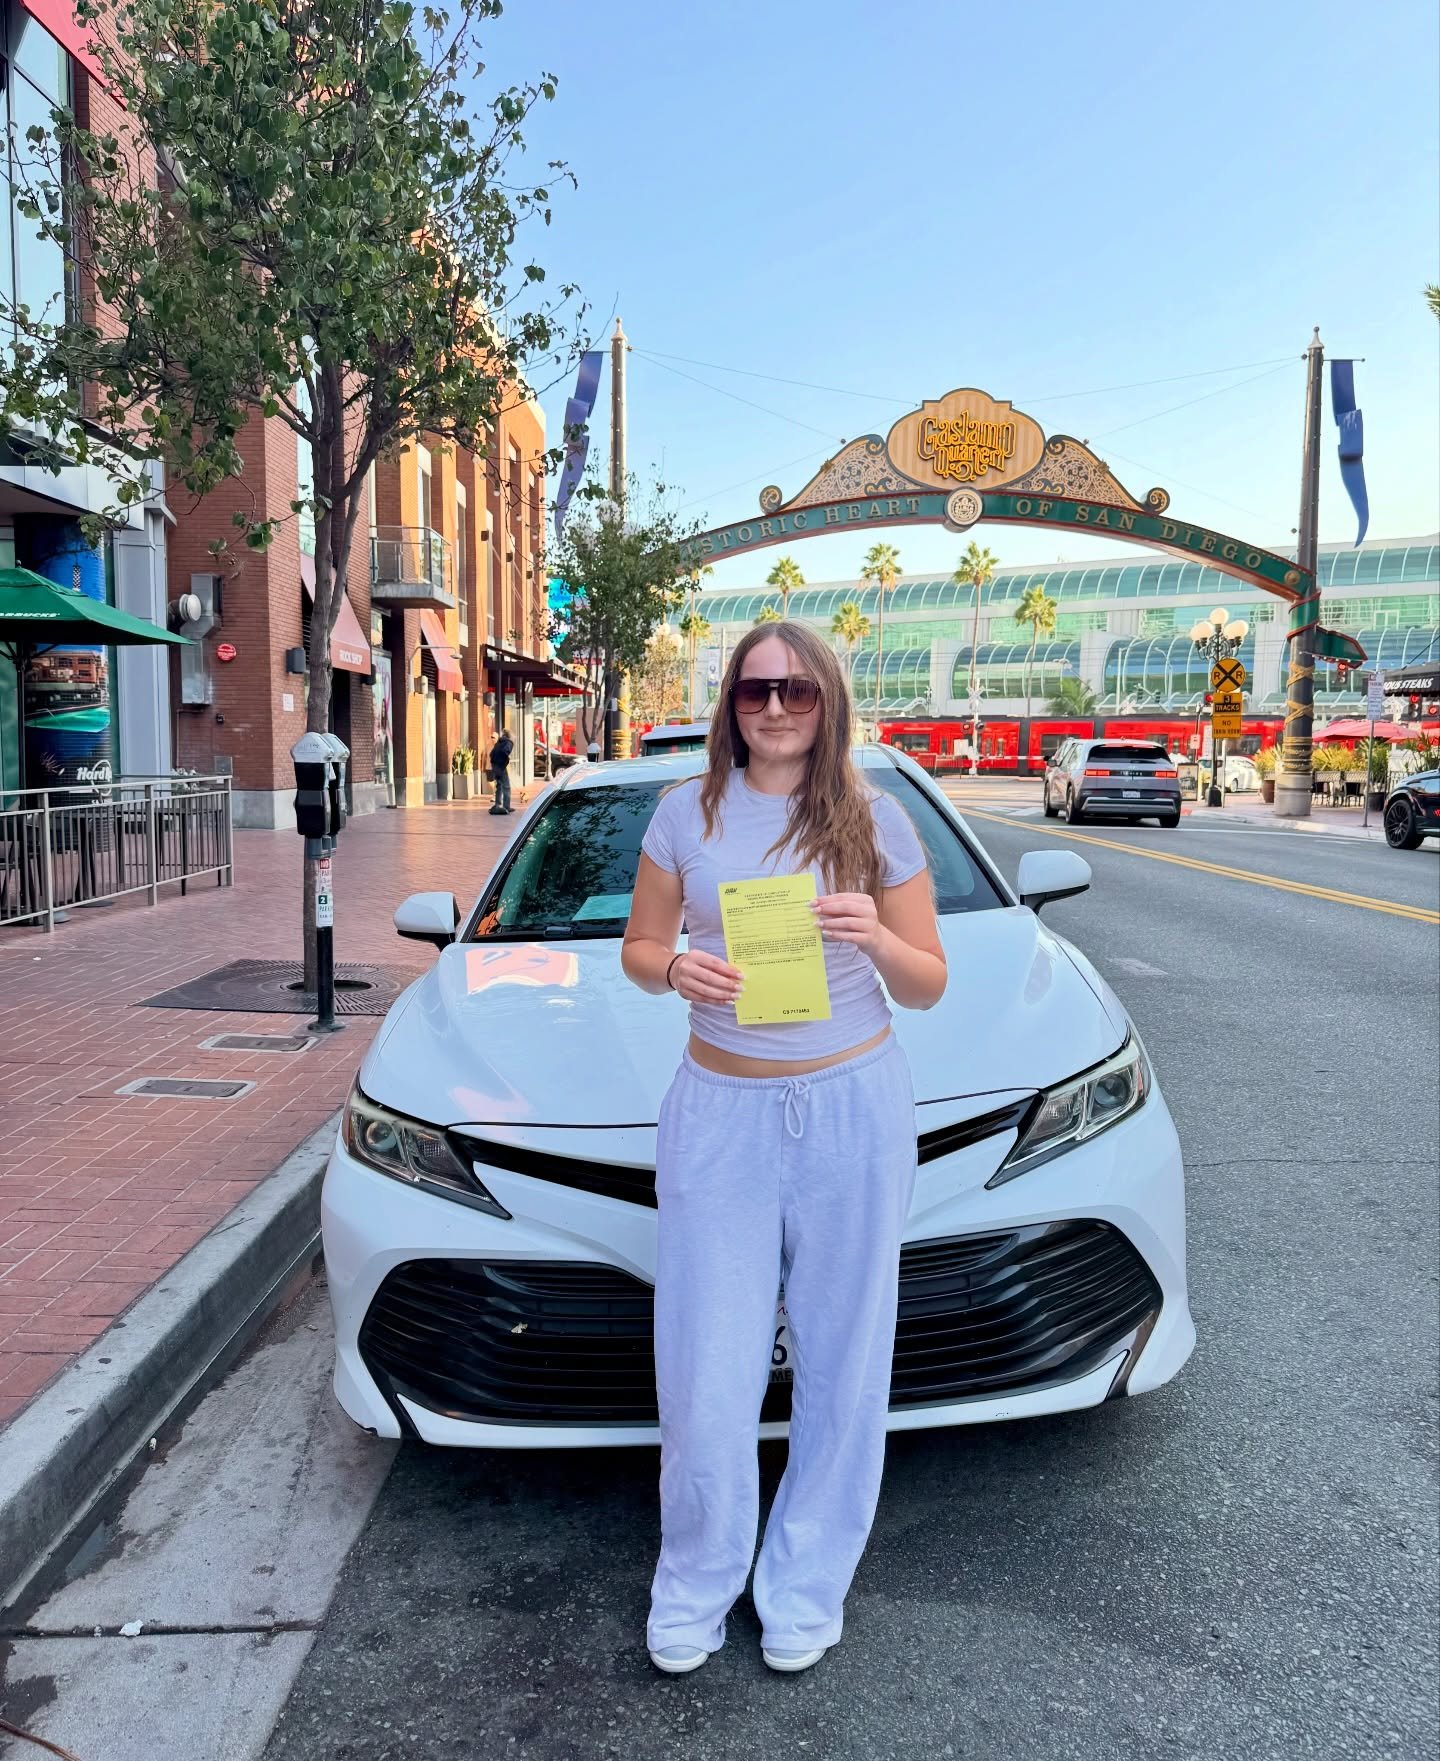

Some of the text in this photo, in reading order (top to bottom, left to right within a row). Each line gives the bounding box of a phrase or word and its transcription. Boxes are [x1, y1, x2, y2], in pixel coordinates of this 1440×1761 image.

[917, 409, 1016, 460] Gaslamp
[933, 444, 1005, 482] Quarter
[684, 512, 808, 558] ISTORIC
[823, 498, 921, 525] HEART
[1015, 499, 1053, 517] OF
[1074, 504, 1137, 531] SAN
[1160, 524, 1261, 568] DIEGO
[1213, 670, 1243, 680] R R
[1383, 678, 1434, 690] OUS STEAKS
[1224, 695, 1231, 703] 3
[1215, 704, 1240, 712] TRACKS
[77, 766, 105, 781] Hard
[320, 896, 326, 904] 2
